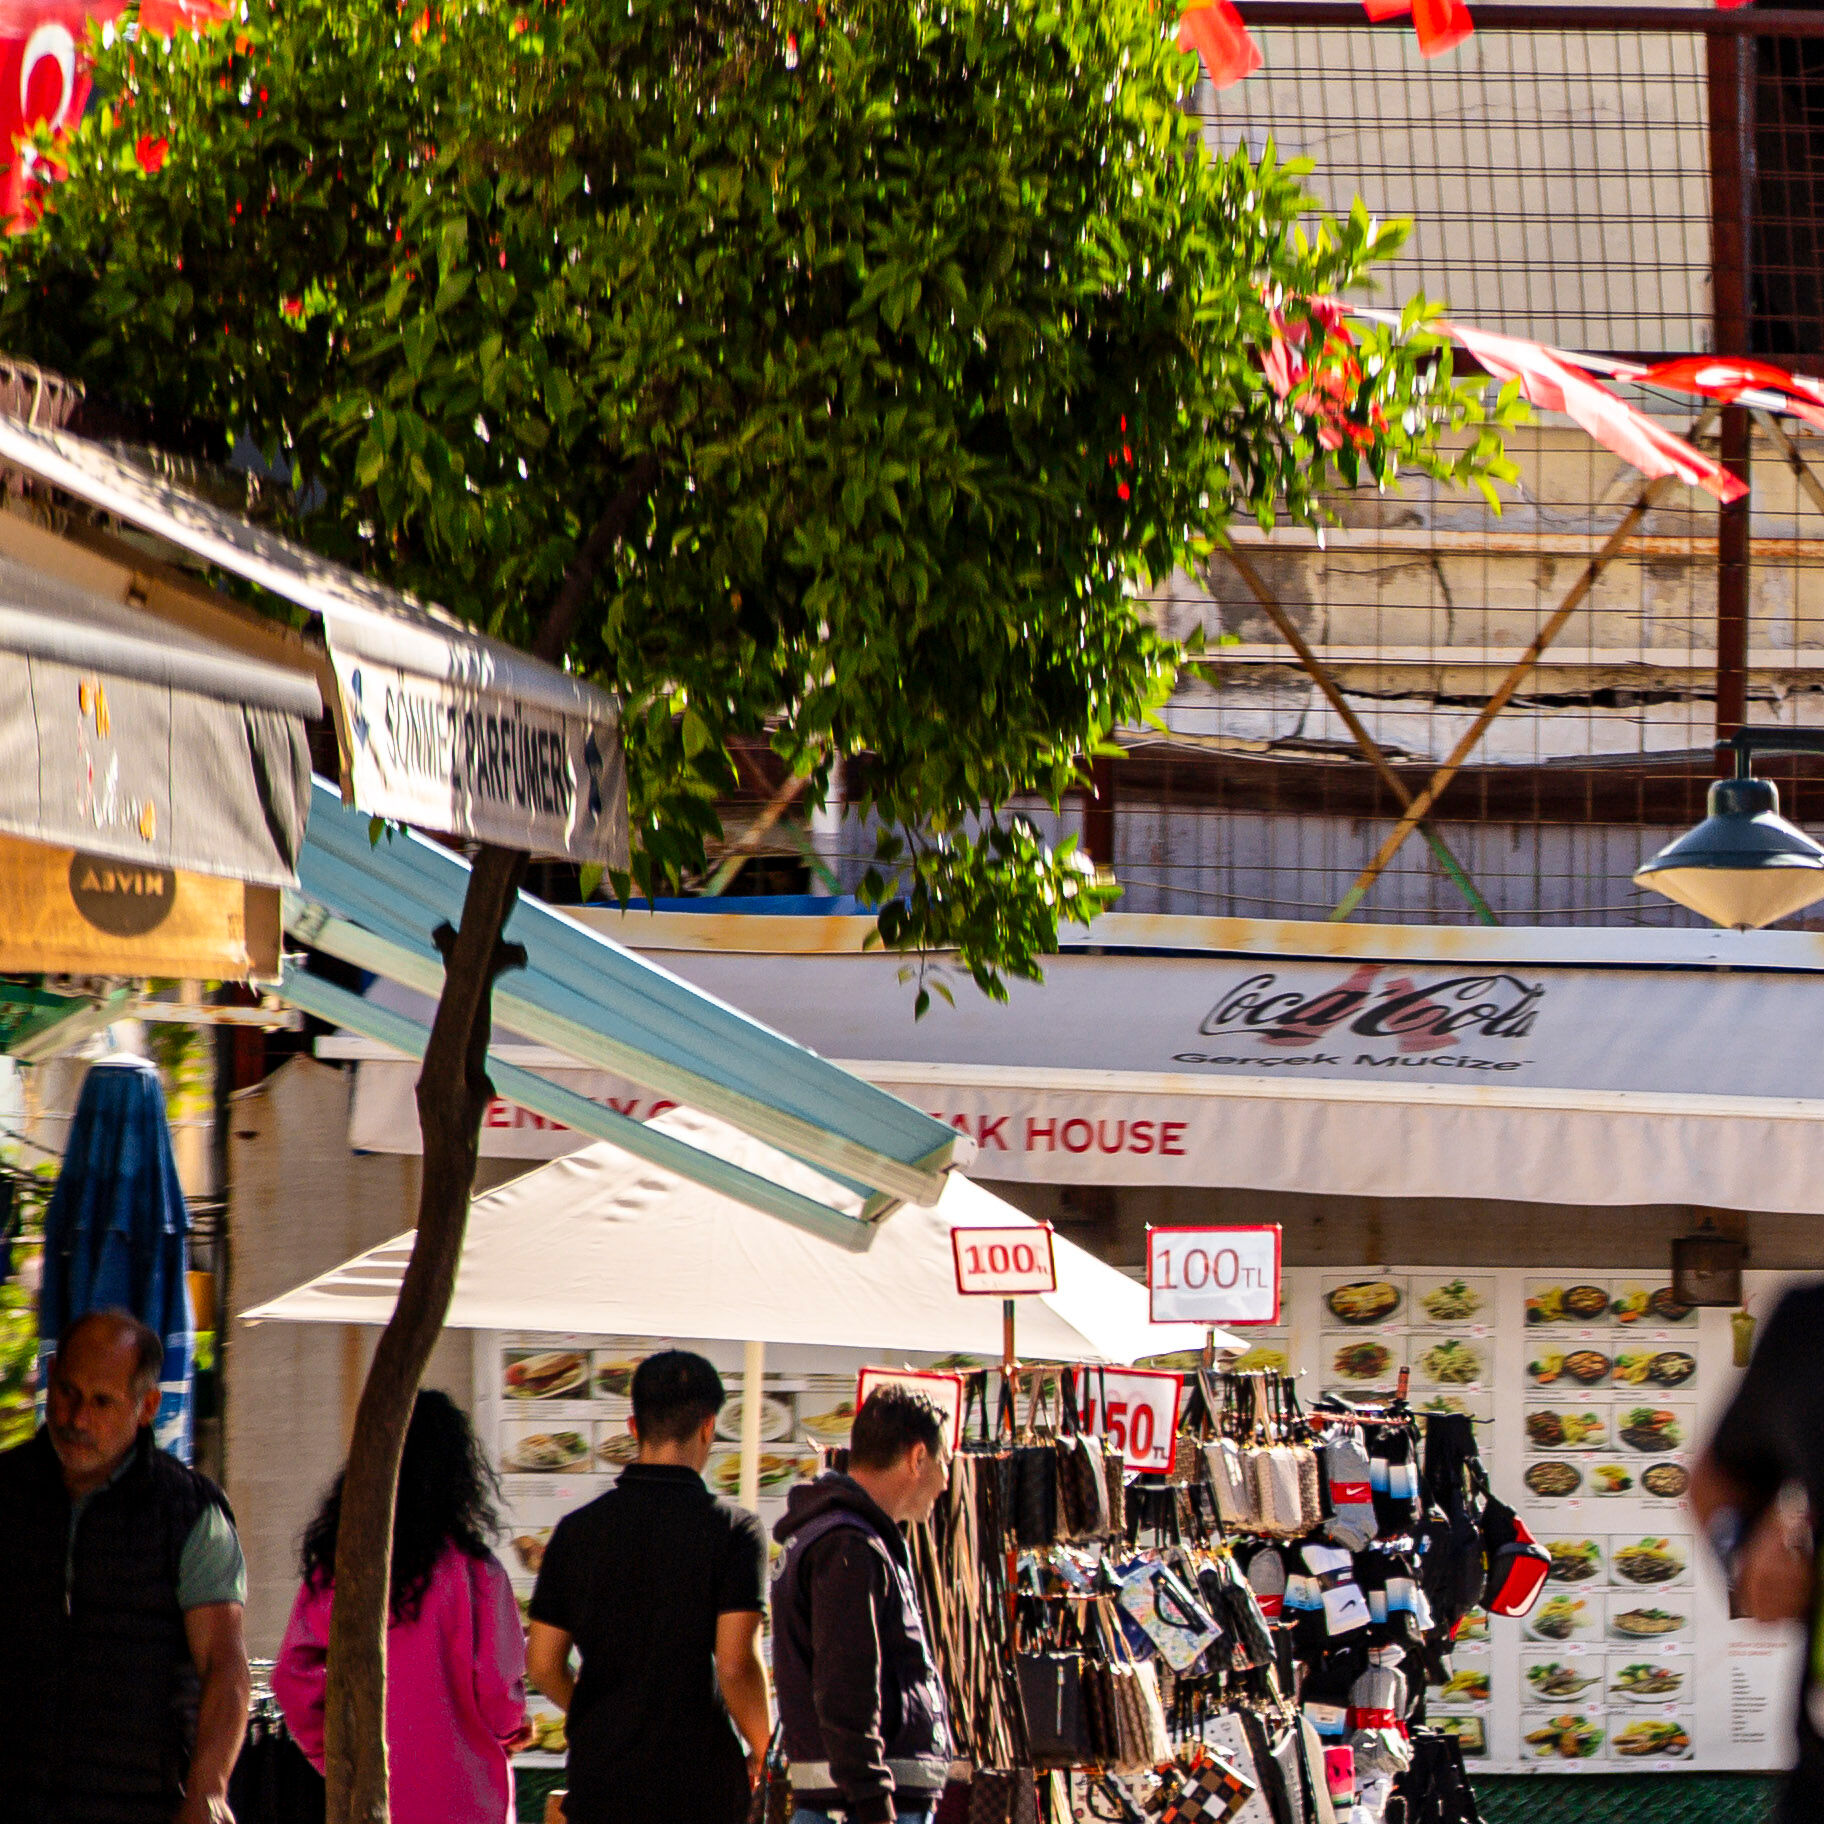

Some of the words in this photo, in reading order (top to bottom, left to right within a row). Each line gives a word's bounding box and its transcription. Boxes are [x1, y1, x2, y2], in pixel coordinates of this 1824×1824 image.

[1200, 973, 1546, 1039] Coca-Cola
[1170, 1053, 1342, 1068] Gerçek
[1025, 1116, 1190, 1156] HOUSE
[966, 1243, 1035, 1275] 100
[1155, 1247, 1240, 1290] 100
[1241, 1266, 1269, 1289] TL
